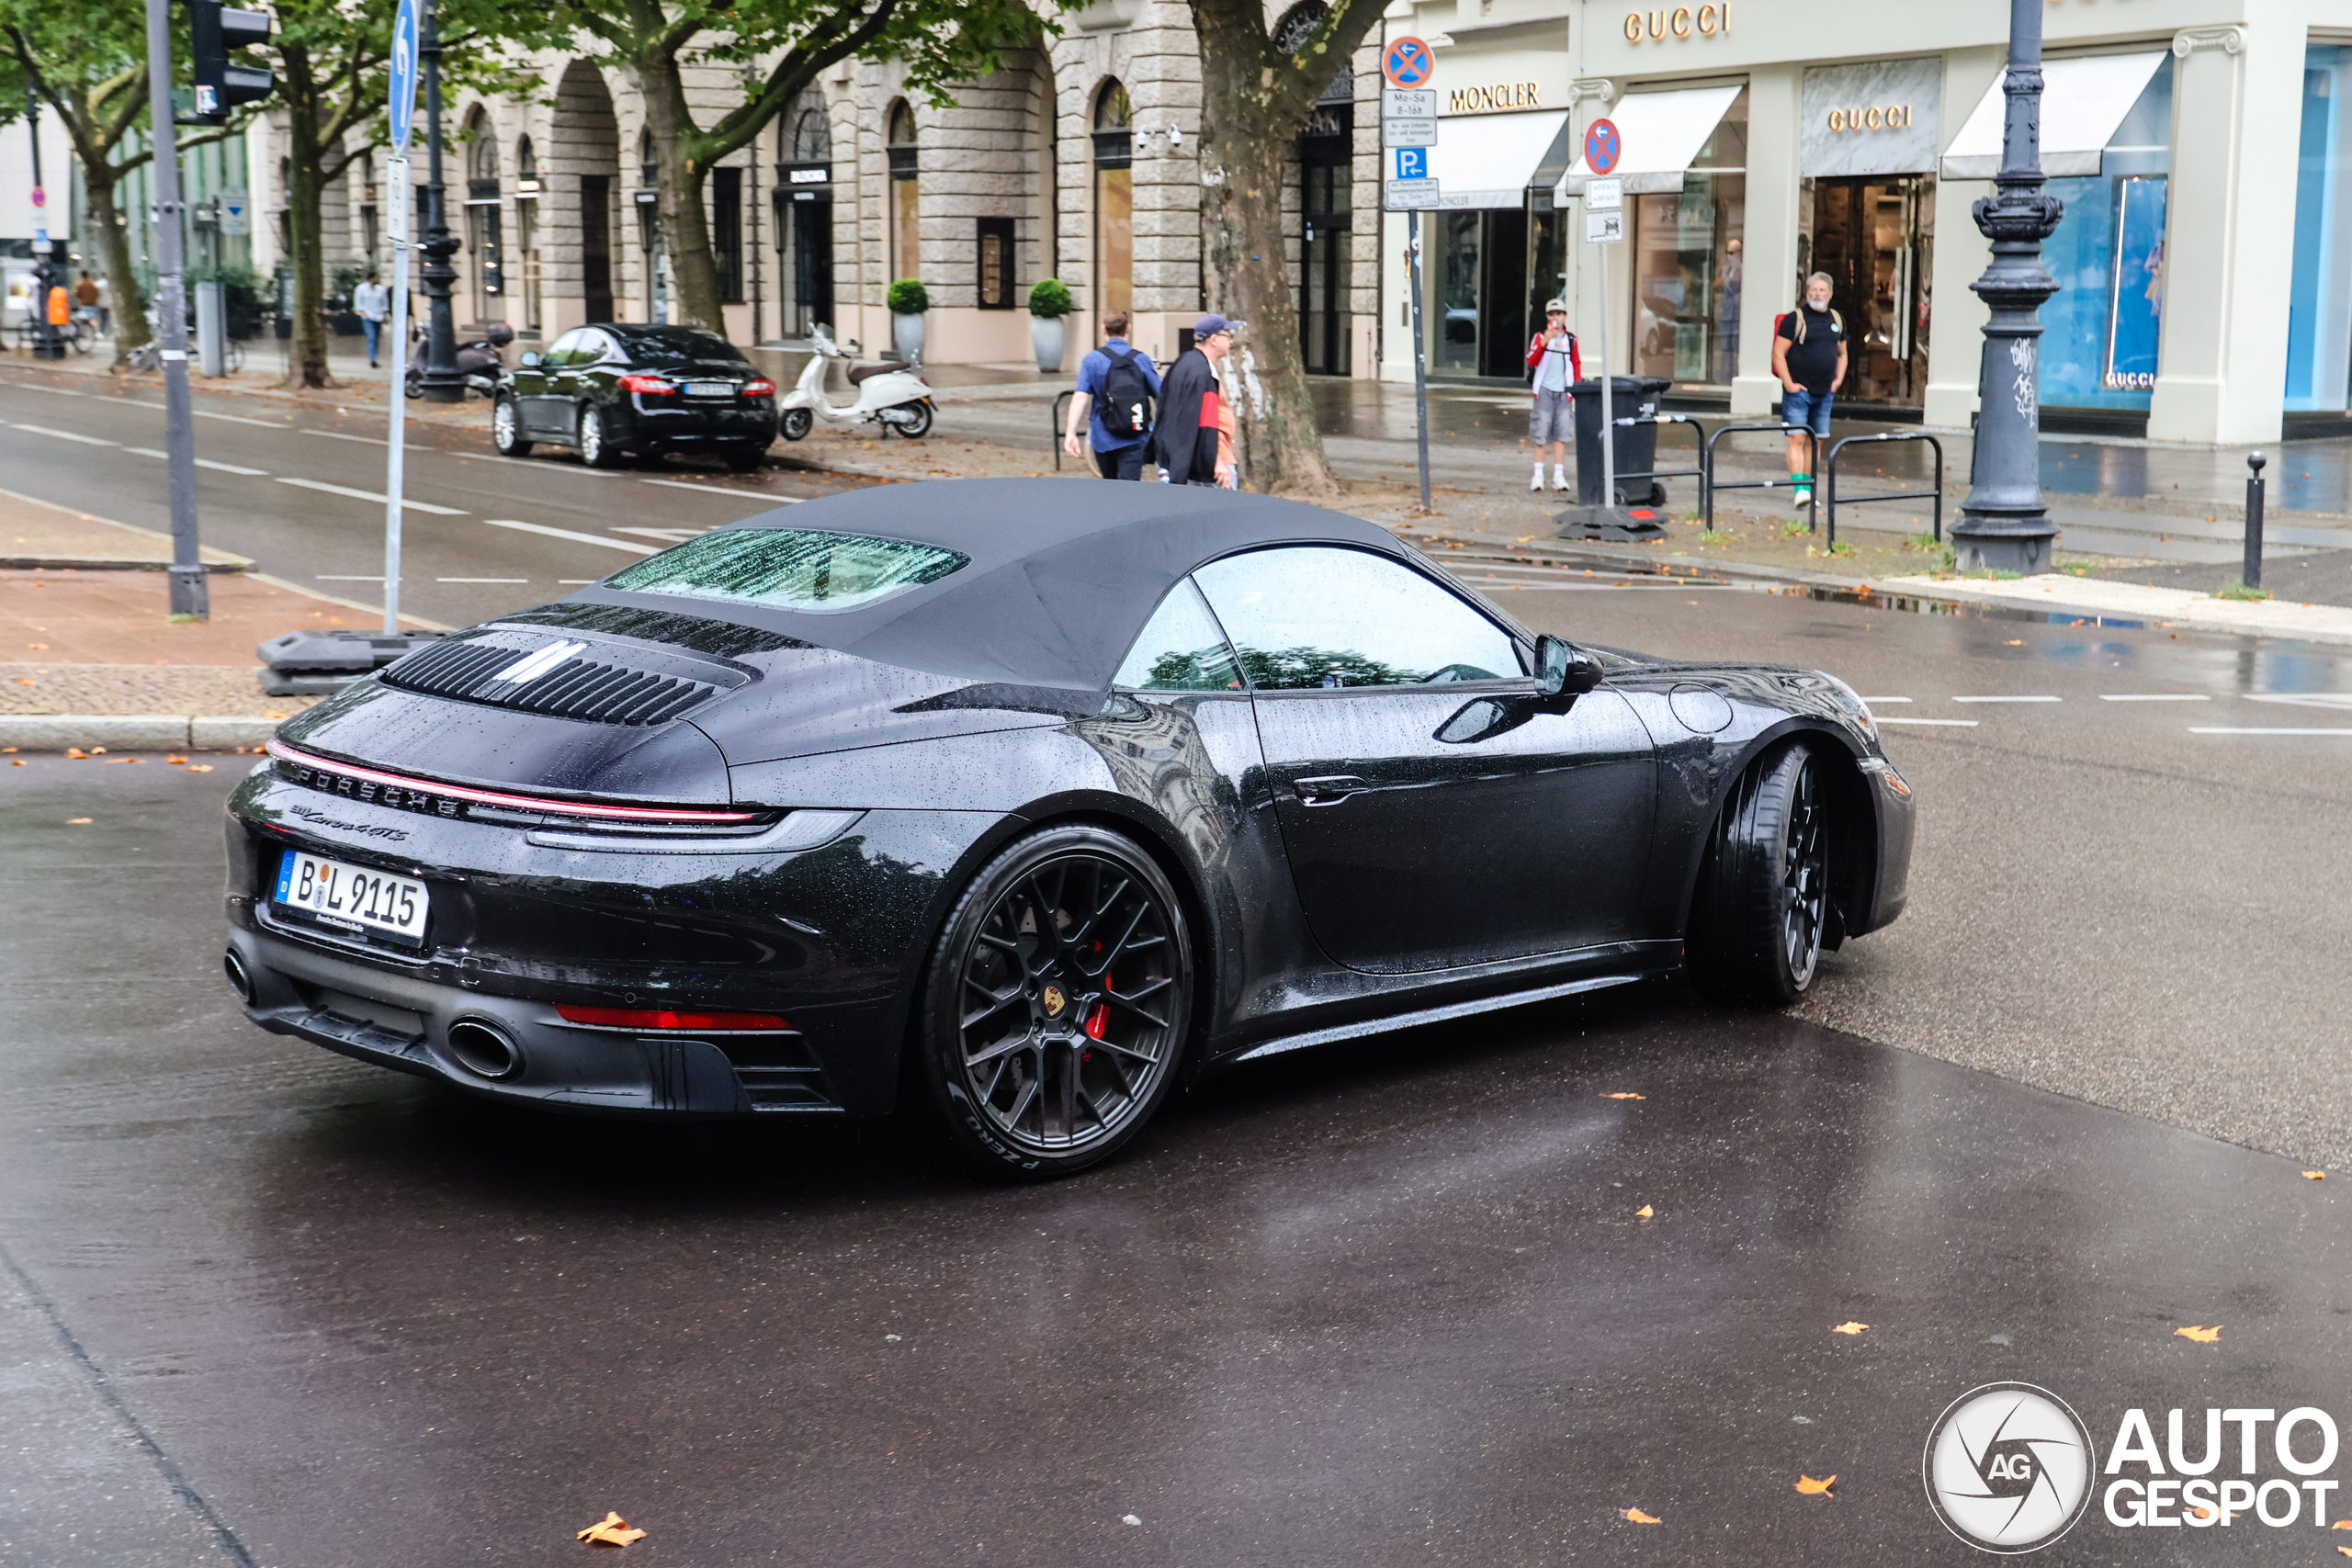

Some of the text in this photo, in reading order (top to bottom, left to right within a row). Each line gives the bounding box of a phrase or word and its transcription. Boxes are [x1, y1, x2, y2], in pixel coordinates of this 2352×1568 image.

[1624, 2, 1731, 42] GUCCI
[1394, 94, 1426, 103] Mo-Sa
[1451, 81, 1542, 113] MONCLER
[1828, 104, 1913, 132] GUCCI
[1400, 151, 1418, 175] P
[2107, 371, 2154, 388] GUCCI
[1131, 402, 1144, 431] FILA
[299, 769, 458, 815] PORSCHE
[368, 828, 410, 841] GTS
[299, 861, 418, 928] B L 9115
